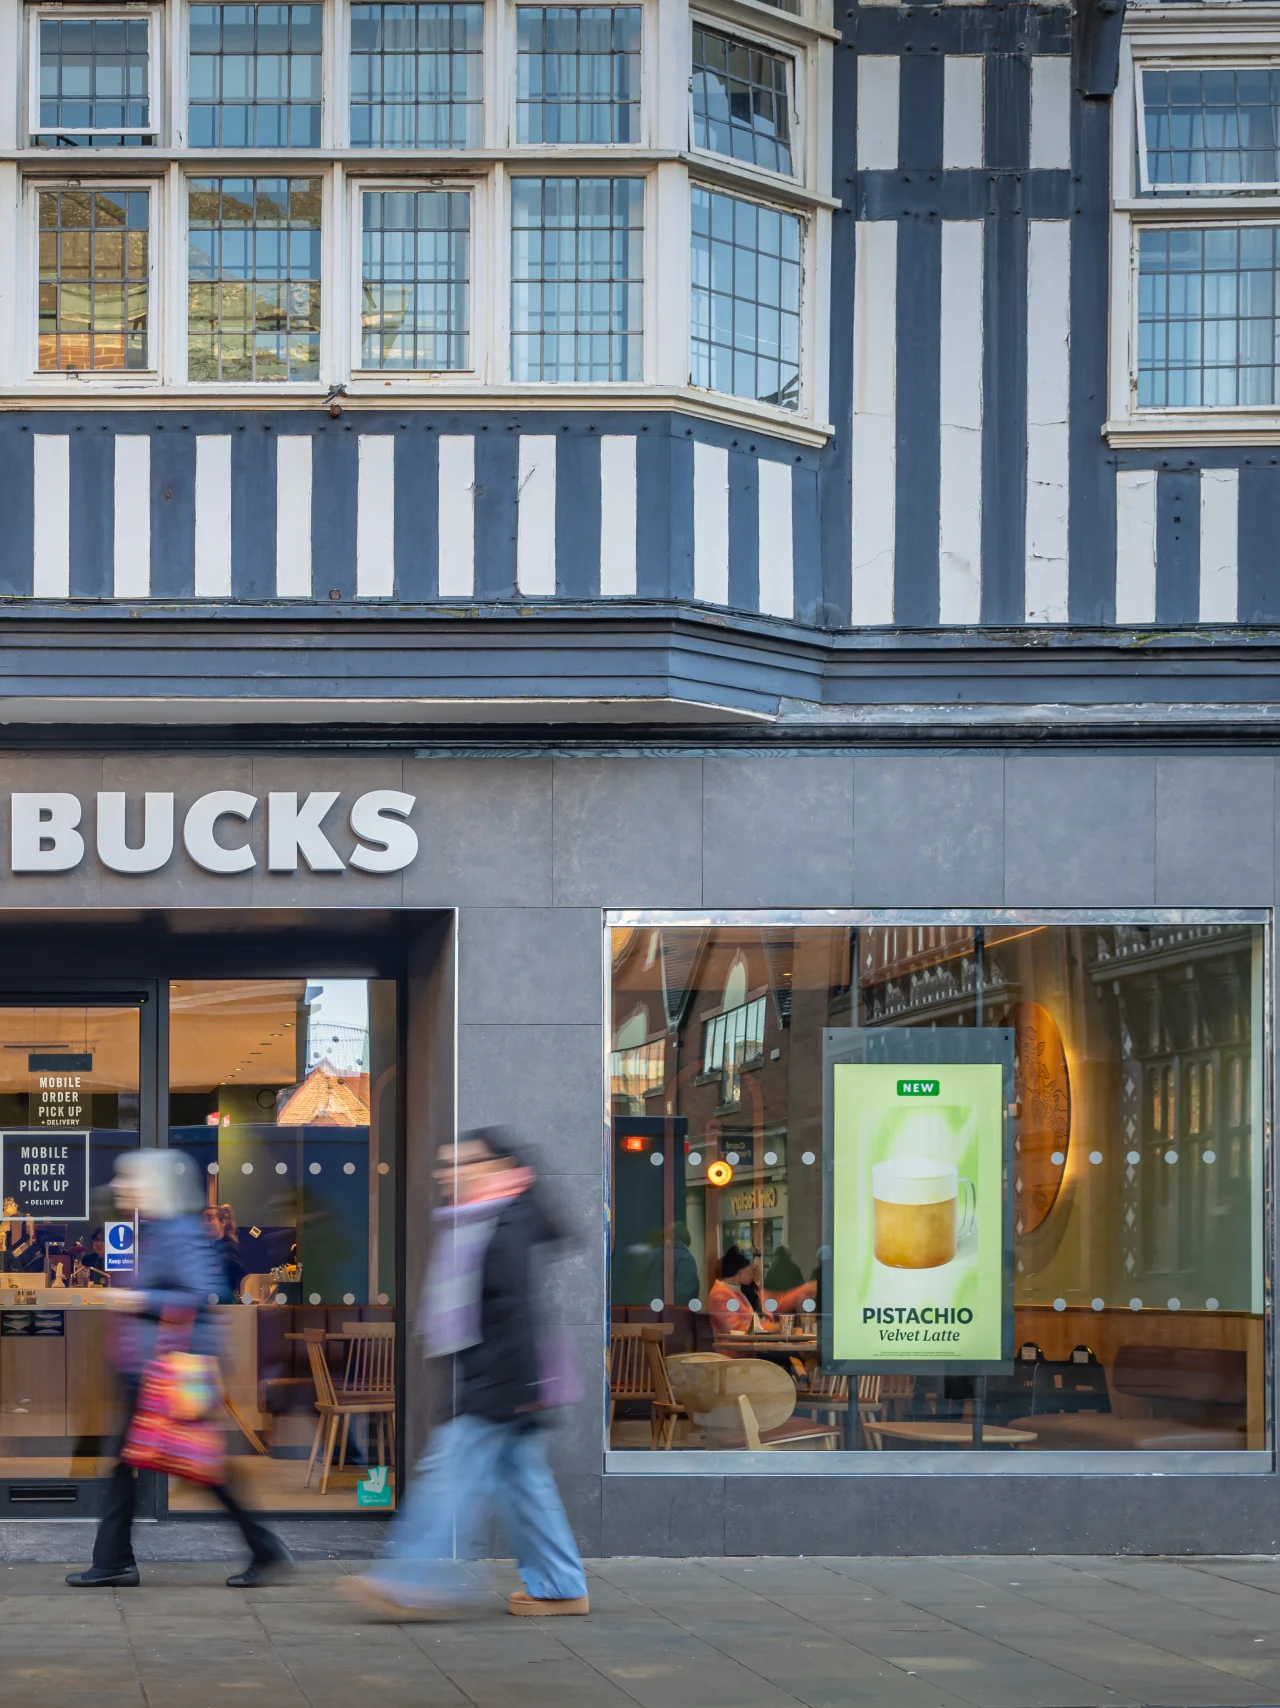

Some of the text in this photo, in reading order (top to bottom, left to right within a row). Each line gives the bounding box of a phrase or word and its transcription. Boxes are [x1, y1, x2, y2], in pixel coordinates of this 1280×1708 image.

[39, 1077, 81, 1088] MOBILE
[902, 1083, 934, 1093] NEW
[42, 1091, 79, 1102] ORDER
[38, 1106, 82, 1117] PICK UP
[21, 1146, 68, 1159] MOBILE
[23, 1163, 66, 1175] ORDER
[19, 1180, 70, 1192] PICK UP
[862, 1307, 974, 1324] PISTACHIO
[879, 1329, 961, 1342] Velvet Latte
